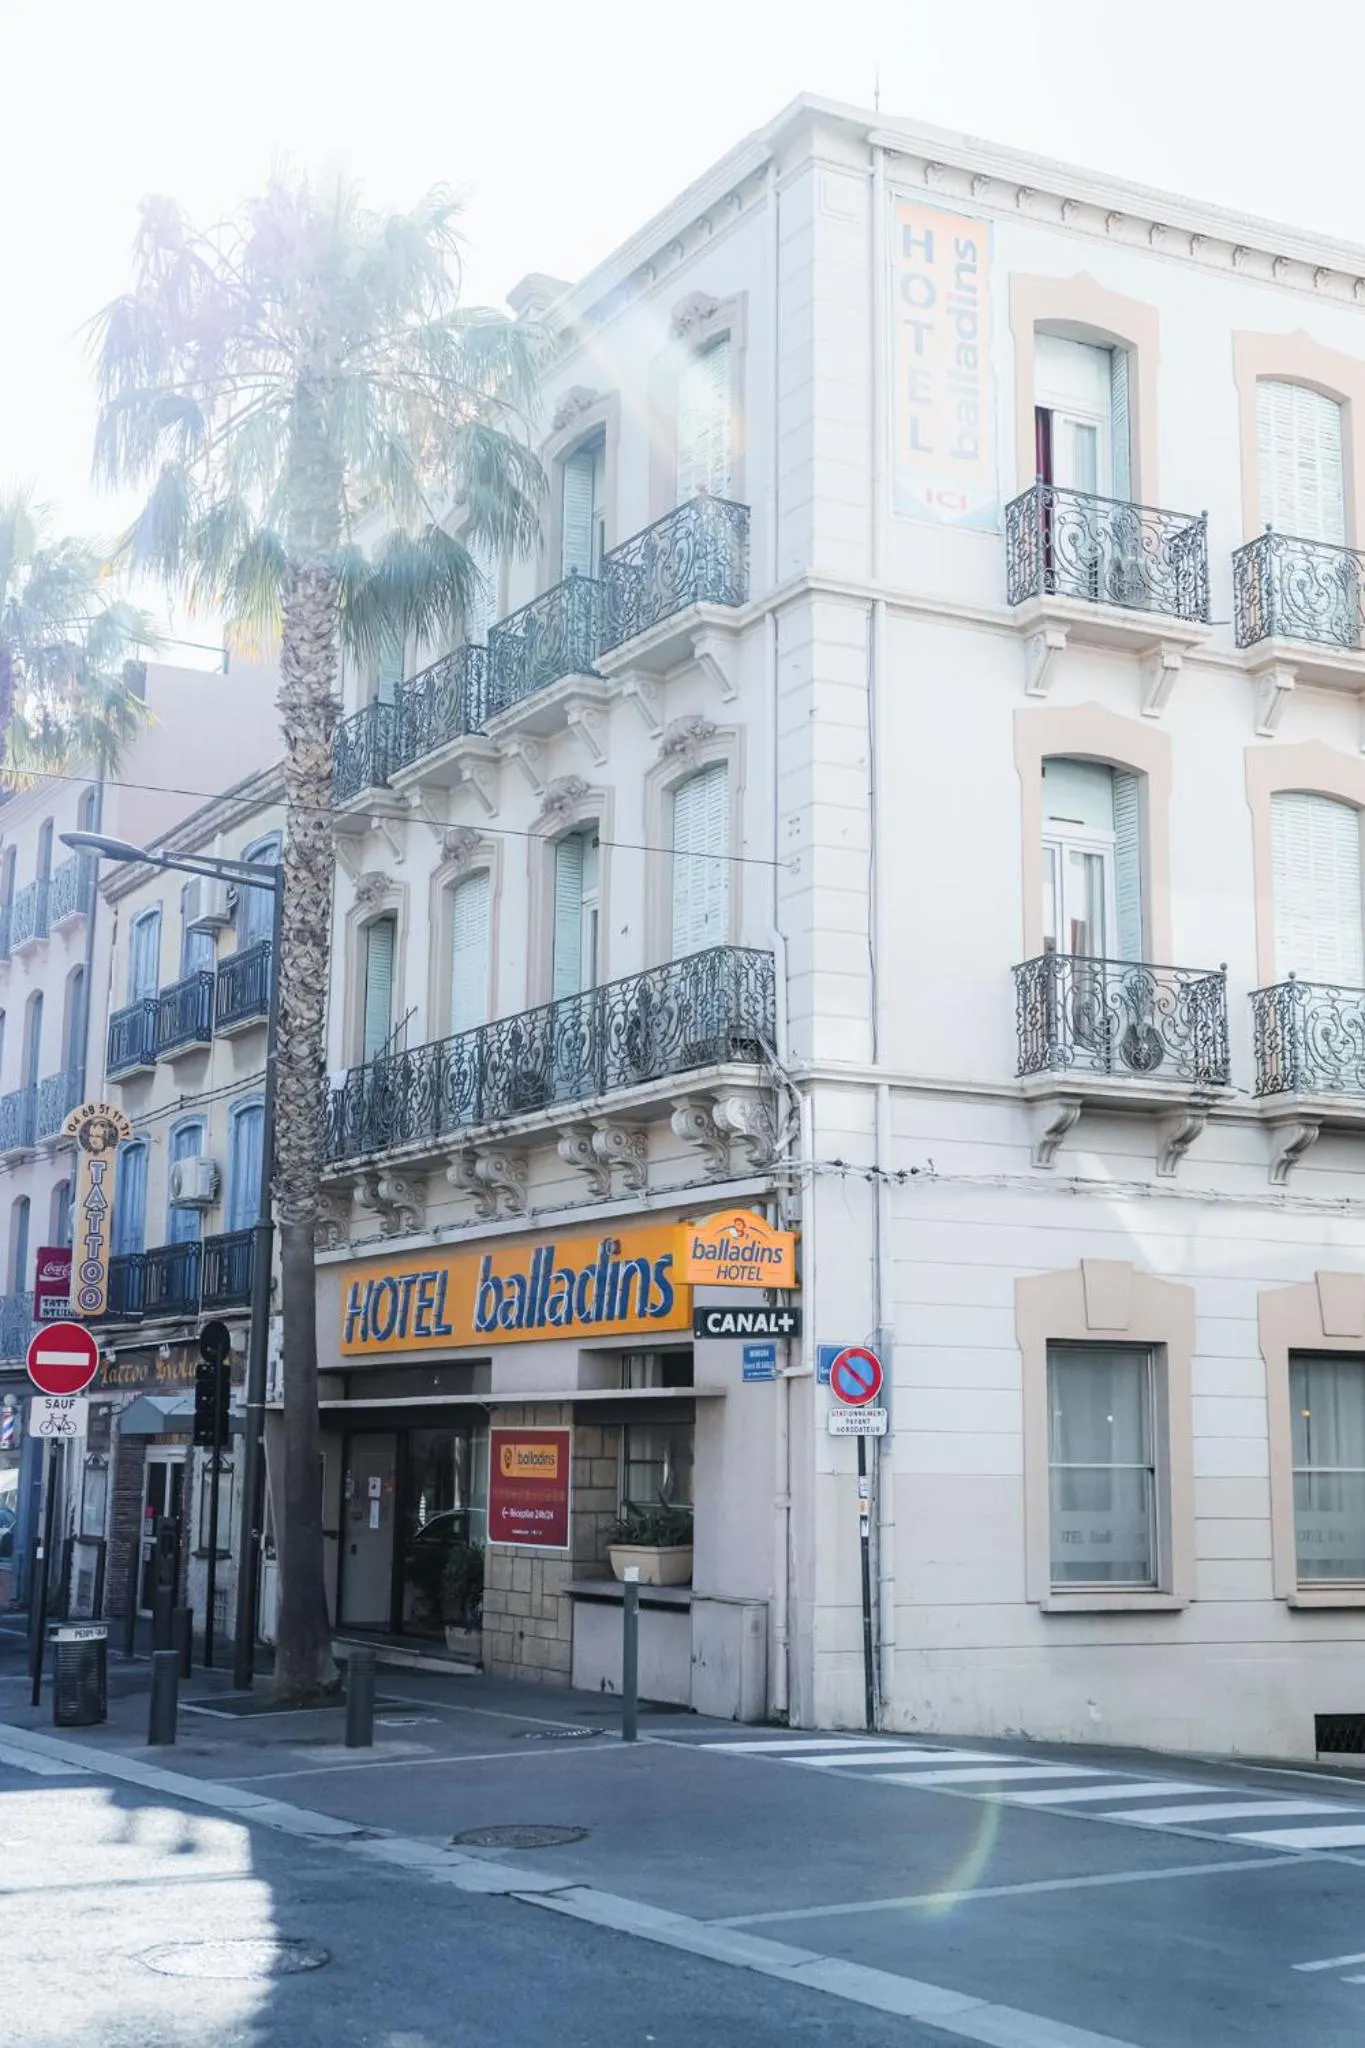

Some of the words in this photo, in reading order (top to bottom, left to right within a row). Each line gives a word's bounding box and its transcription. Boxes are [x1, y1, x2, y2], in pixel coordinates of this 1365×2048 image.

[900, 224, 937, 455] HOTEL
[945, 237, 980, 461] balladins
[925, 488, 967, 510] ICI
[78, 1160, 108, 1311] TATTOO
[692, 1236, 784, 1264] balladins
[716, 1264, 763, 1282] HOTEL
[344, 1269, 453, 1344] HOTEL
[473, 1237, 675, 1334] balladins
[707, 1313, 794, 1333] CANAL+
[45, 1399, 76, 1409] SAUF
[518, 1451, 555, 1466] balladins
